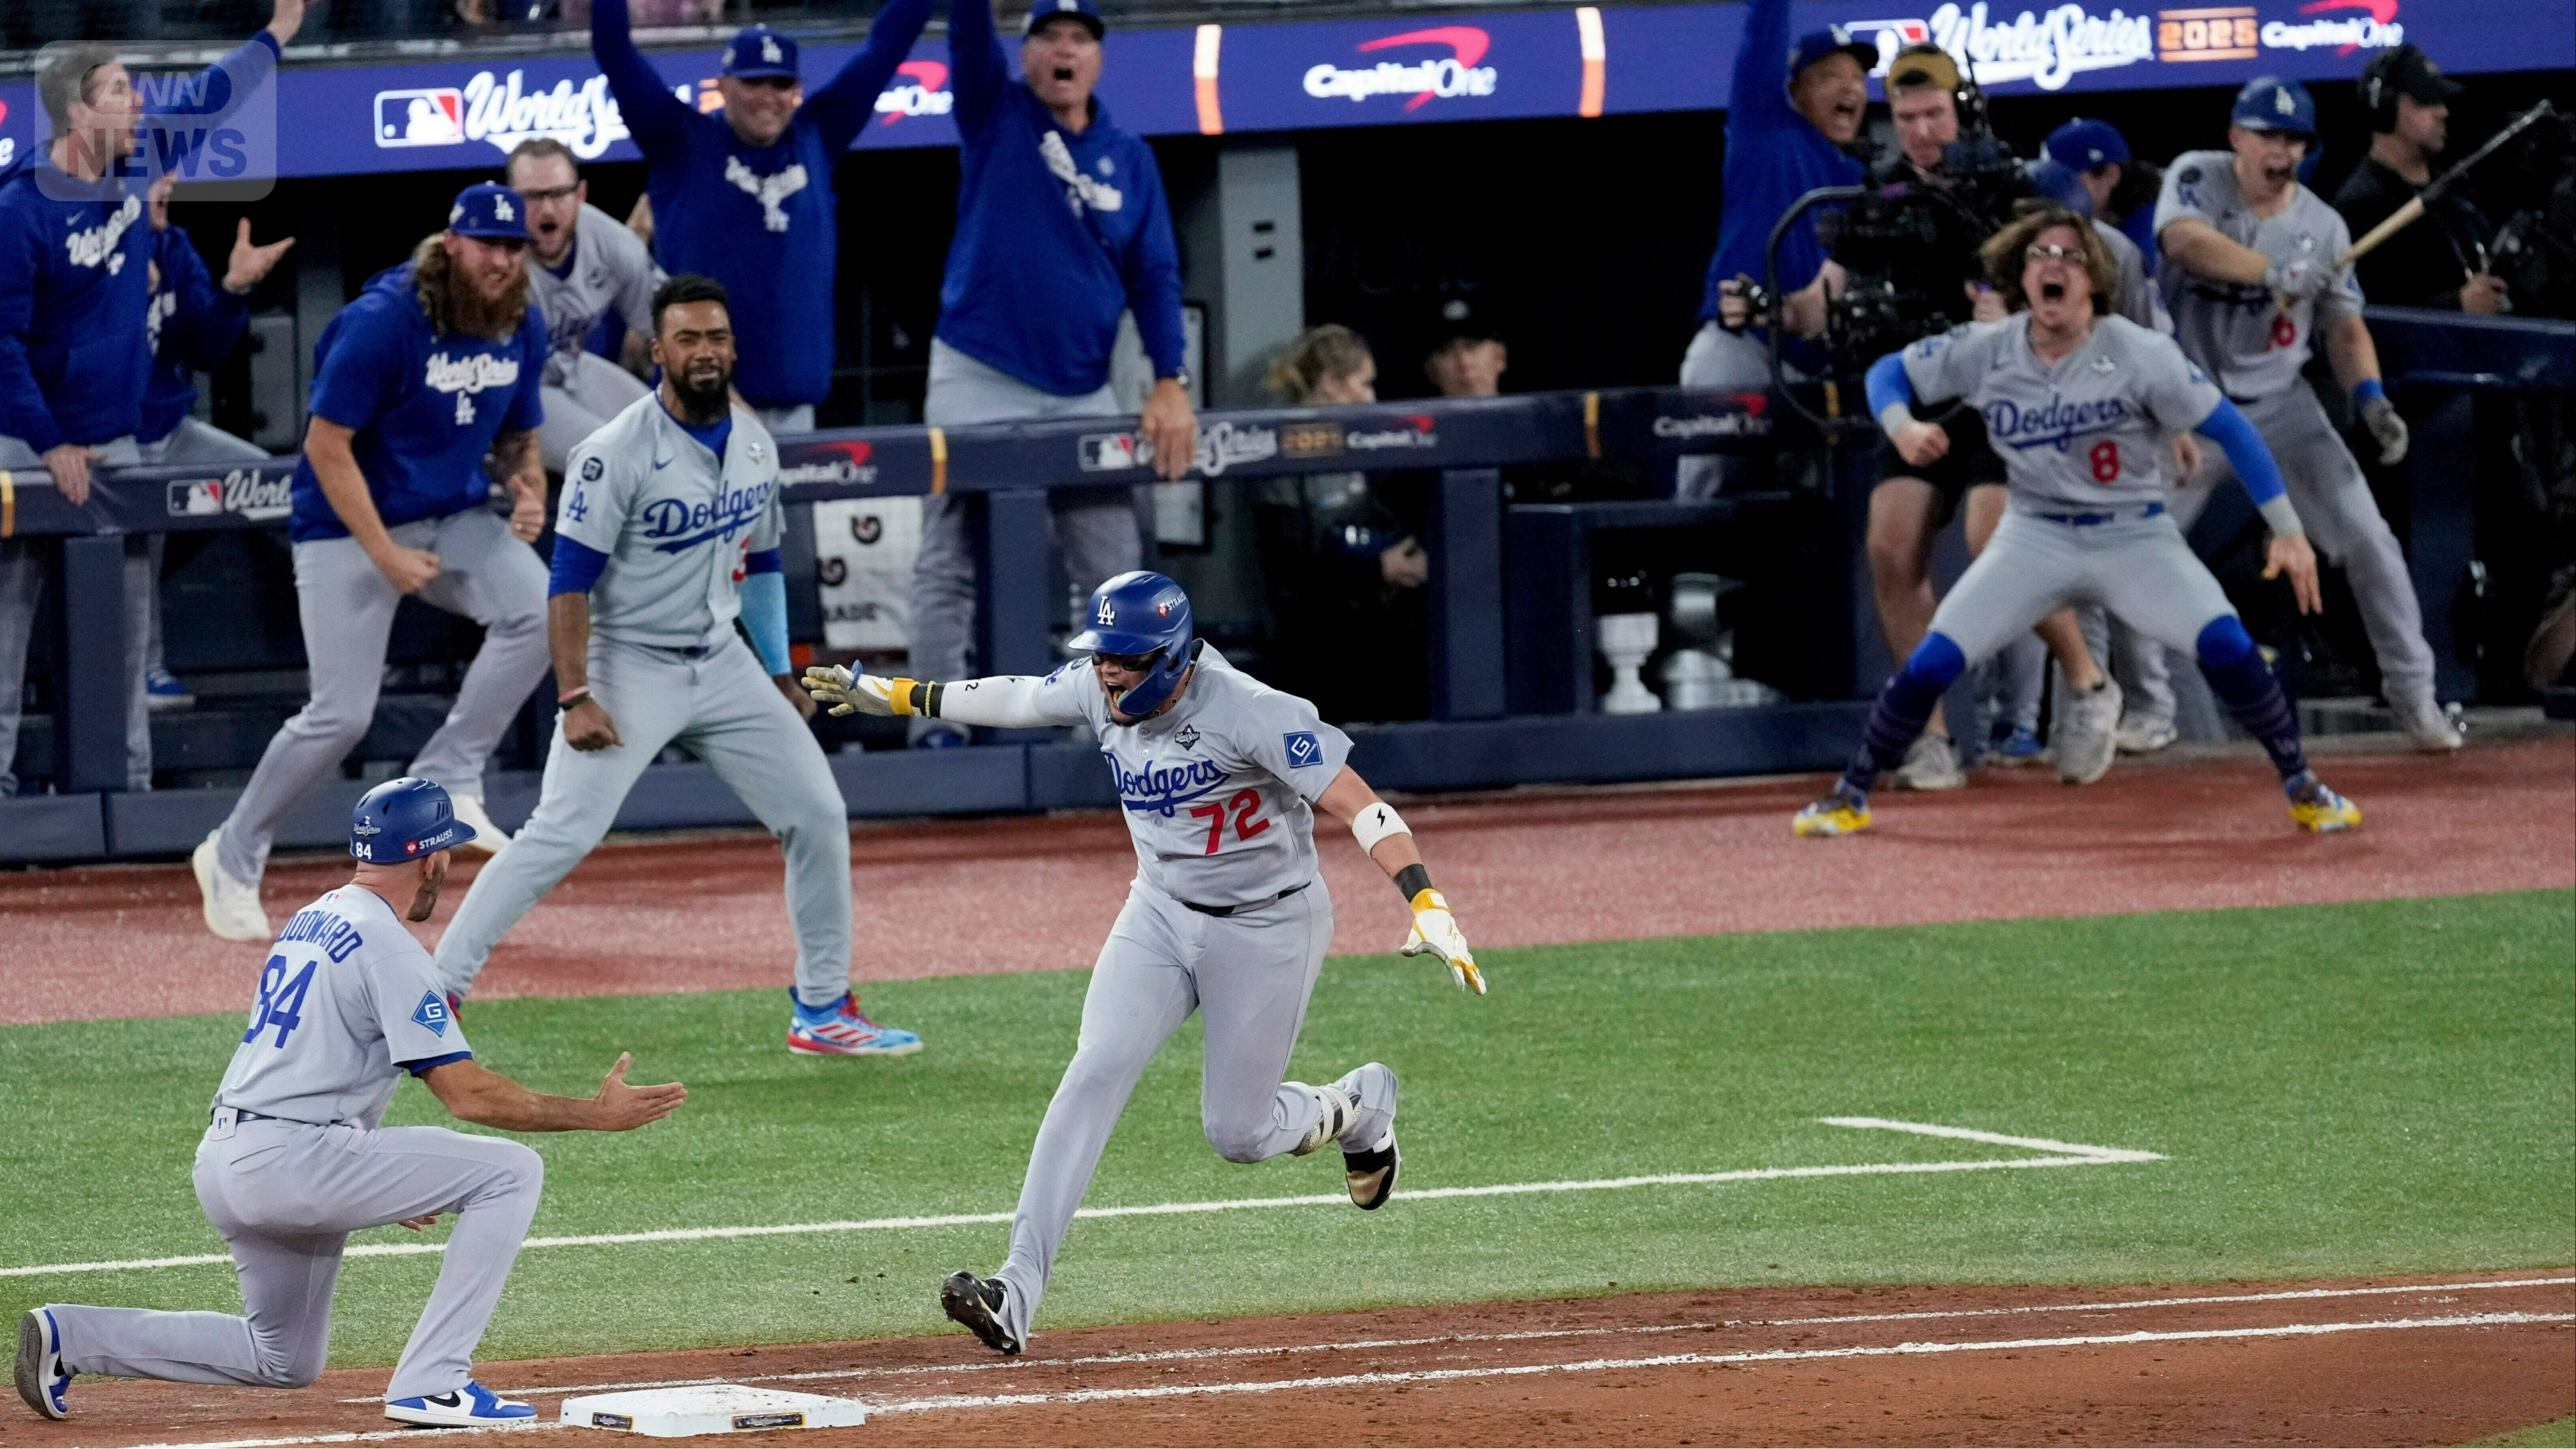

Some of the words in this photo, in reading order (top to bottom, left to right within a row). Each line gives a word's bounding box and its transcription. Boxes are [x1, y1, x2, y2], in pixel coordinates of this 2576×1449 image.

[1983, 393, 2125, 453] Dodgers
[2090, 440, 2120, 484] 8
[1097, 595, 1116, 627] LA
[418, 828, 453, 849] STRAUSS
[1189, 788, 1270, 856] 72
[356, 842, 372, 859] 84
[243, 954, 318, 1049] 84
